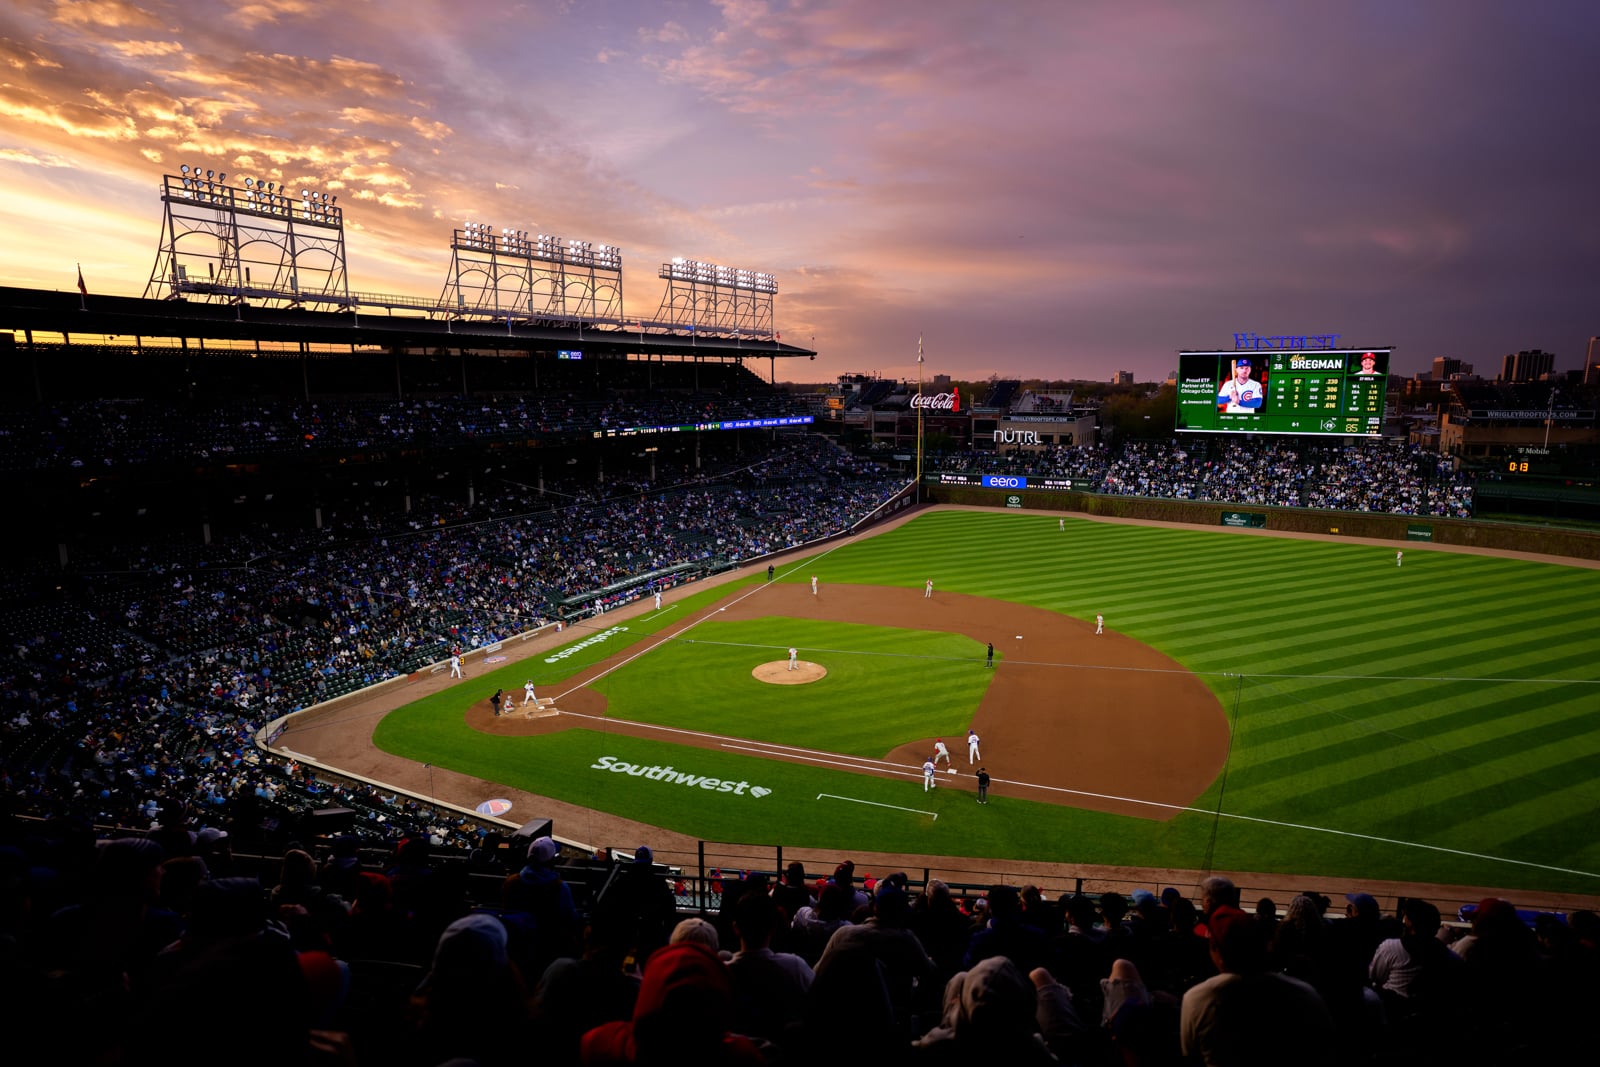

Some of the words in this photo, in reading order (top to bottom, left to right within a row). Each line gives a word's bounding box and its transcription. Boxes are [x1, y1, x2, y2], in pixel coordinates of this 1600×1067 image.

[1291, 360, 1342, 369] BREGMAN
[910, 392, 954, 409] Coca-Cola
[994, 428, 1042, 444] NÜTRL
[1509, 462, 1528, 472] 0:13
[990, 478, 1018, 487] eero
[550, 626, 629, 658] Southwest
[590, 756, 750, 795] Southwest
